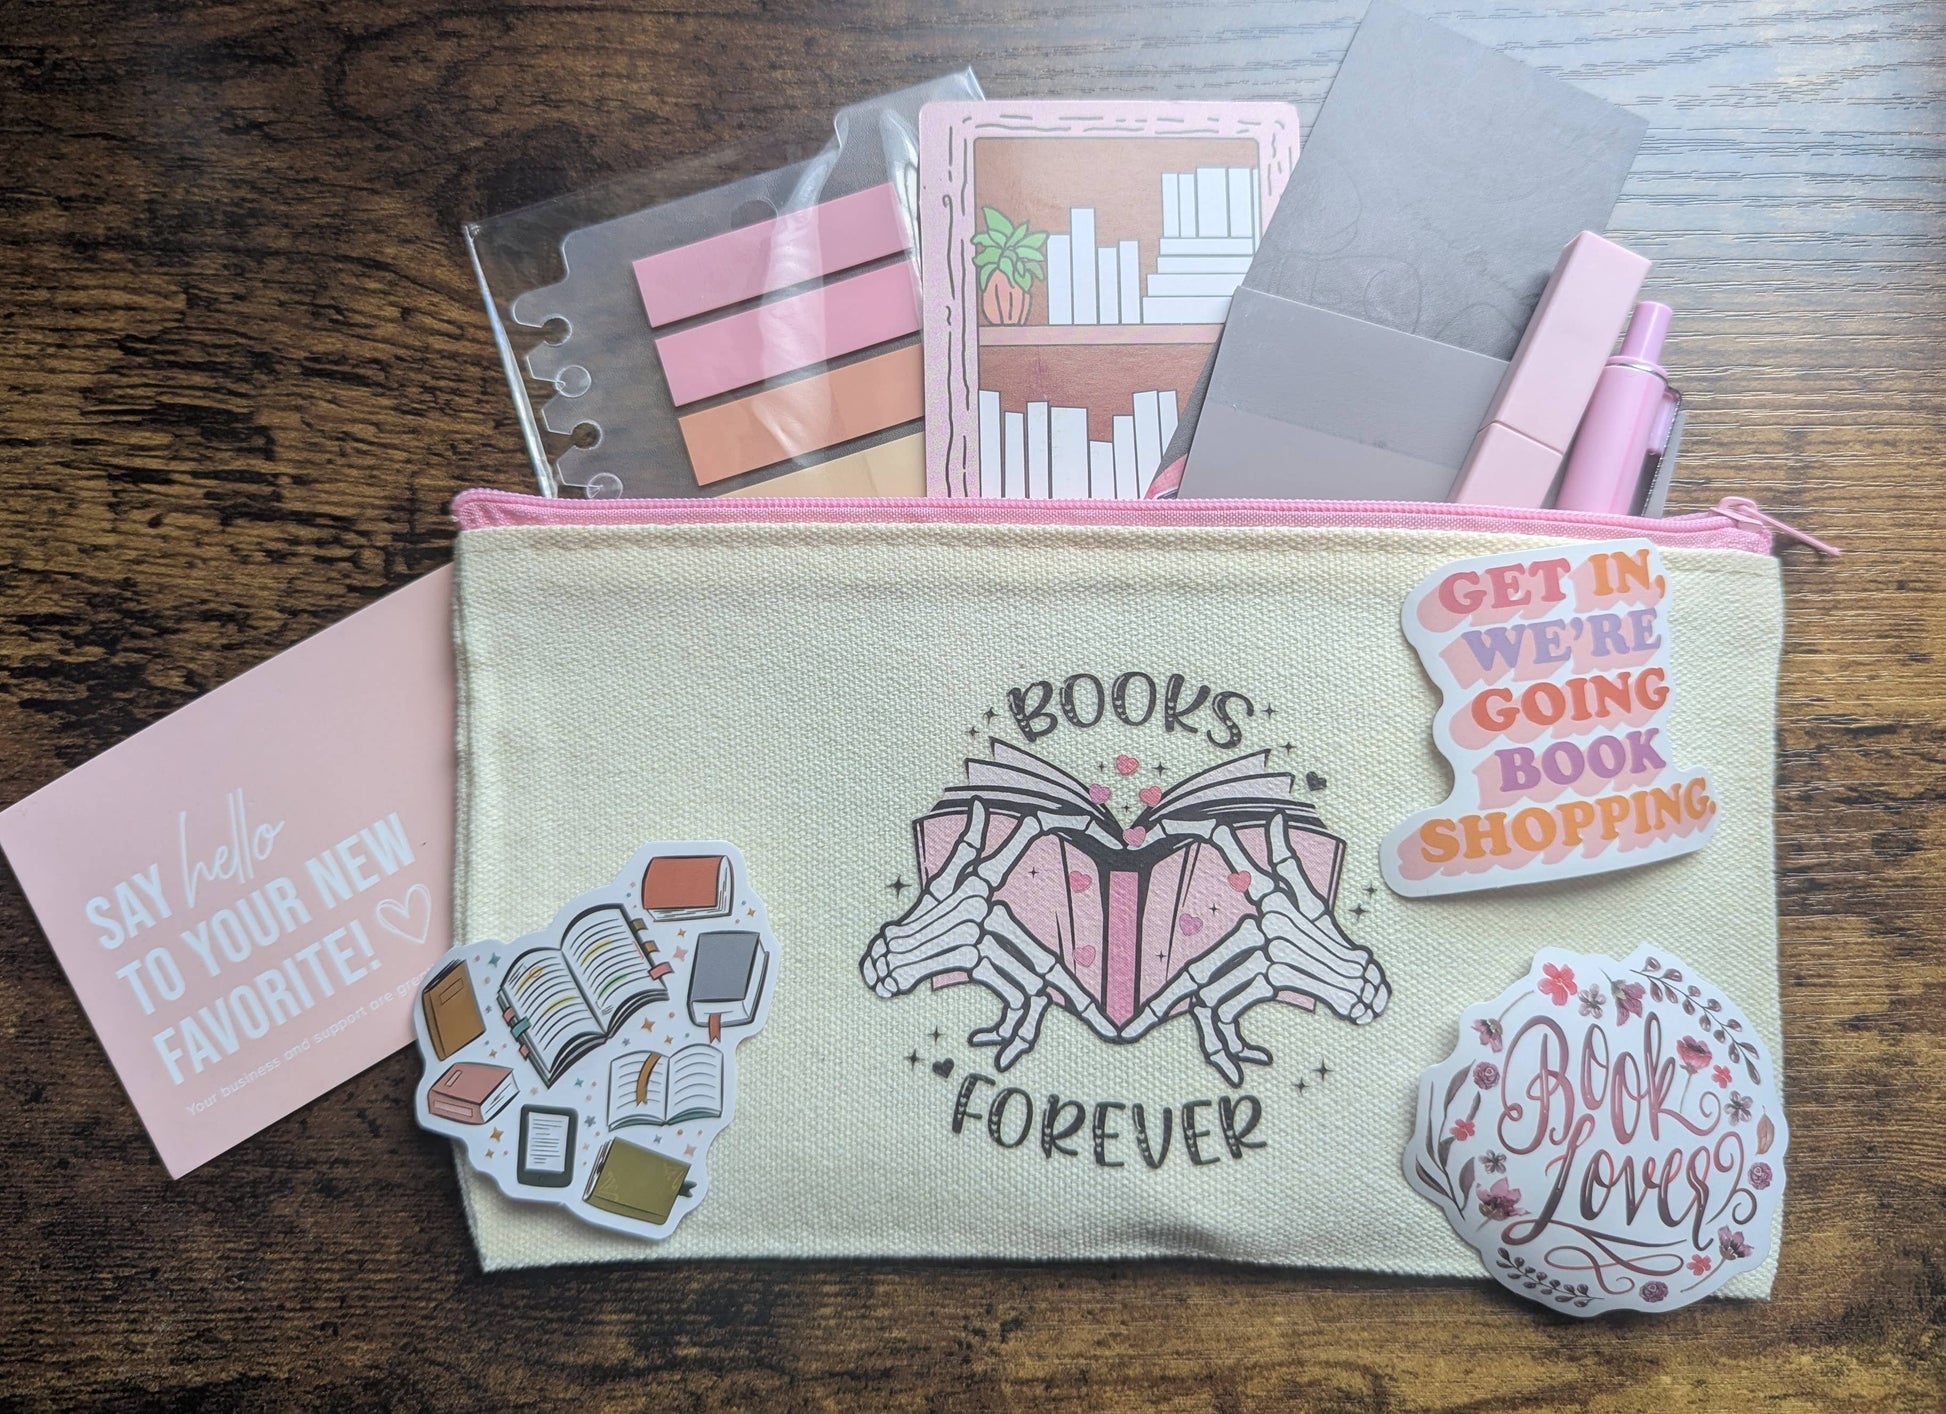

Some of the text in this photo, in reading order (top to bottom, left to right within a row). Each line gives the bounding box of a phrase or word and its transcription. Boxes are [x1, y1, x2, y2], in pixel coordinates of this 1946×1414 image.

[1438, 549, 1666, 615] GET IN,
[1461, 607, 1662, 671] WE'RE
[1007, 671, 1254, 749] BOOKS
[1470, 667, 1670, 732] GOING
[1494, 728, 1667, 792] BOOK
[1419, 777, 1717, 863] SHOPPING.
[85, 787, 286, 950] SAY hello
[116, 811, 416, 1016] TO YOUR NEW
[152, 918, 382, 1087] FAVORITE!
[186, 1093, 218, 1116] Your
[220, 1057, 282, 1098] business
[283, 1038, 311, 1062] and
[313, 1006, 368, 1044] support
[369, 991, 395, 1011] are
[1497, 1011, 1721, 1155] Book
[951, 1072, 1268, 1169] FOREVER
